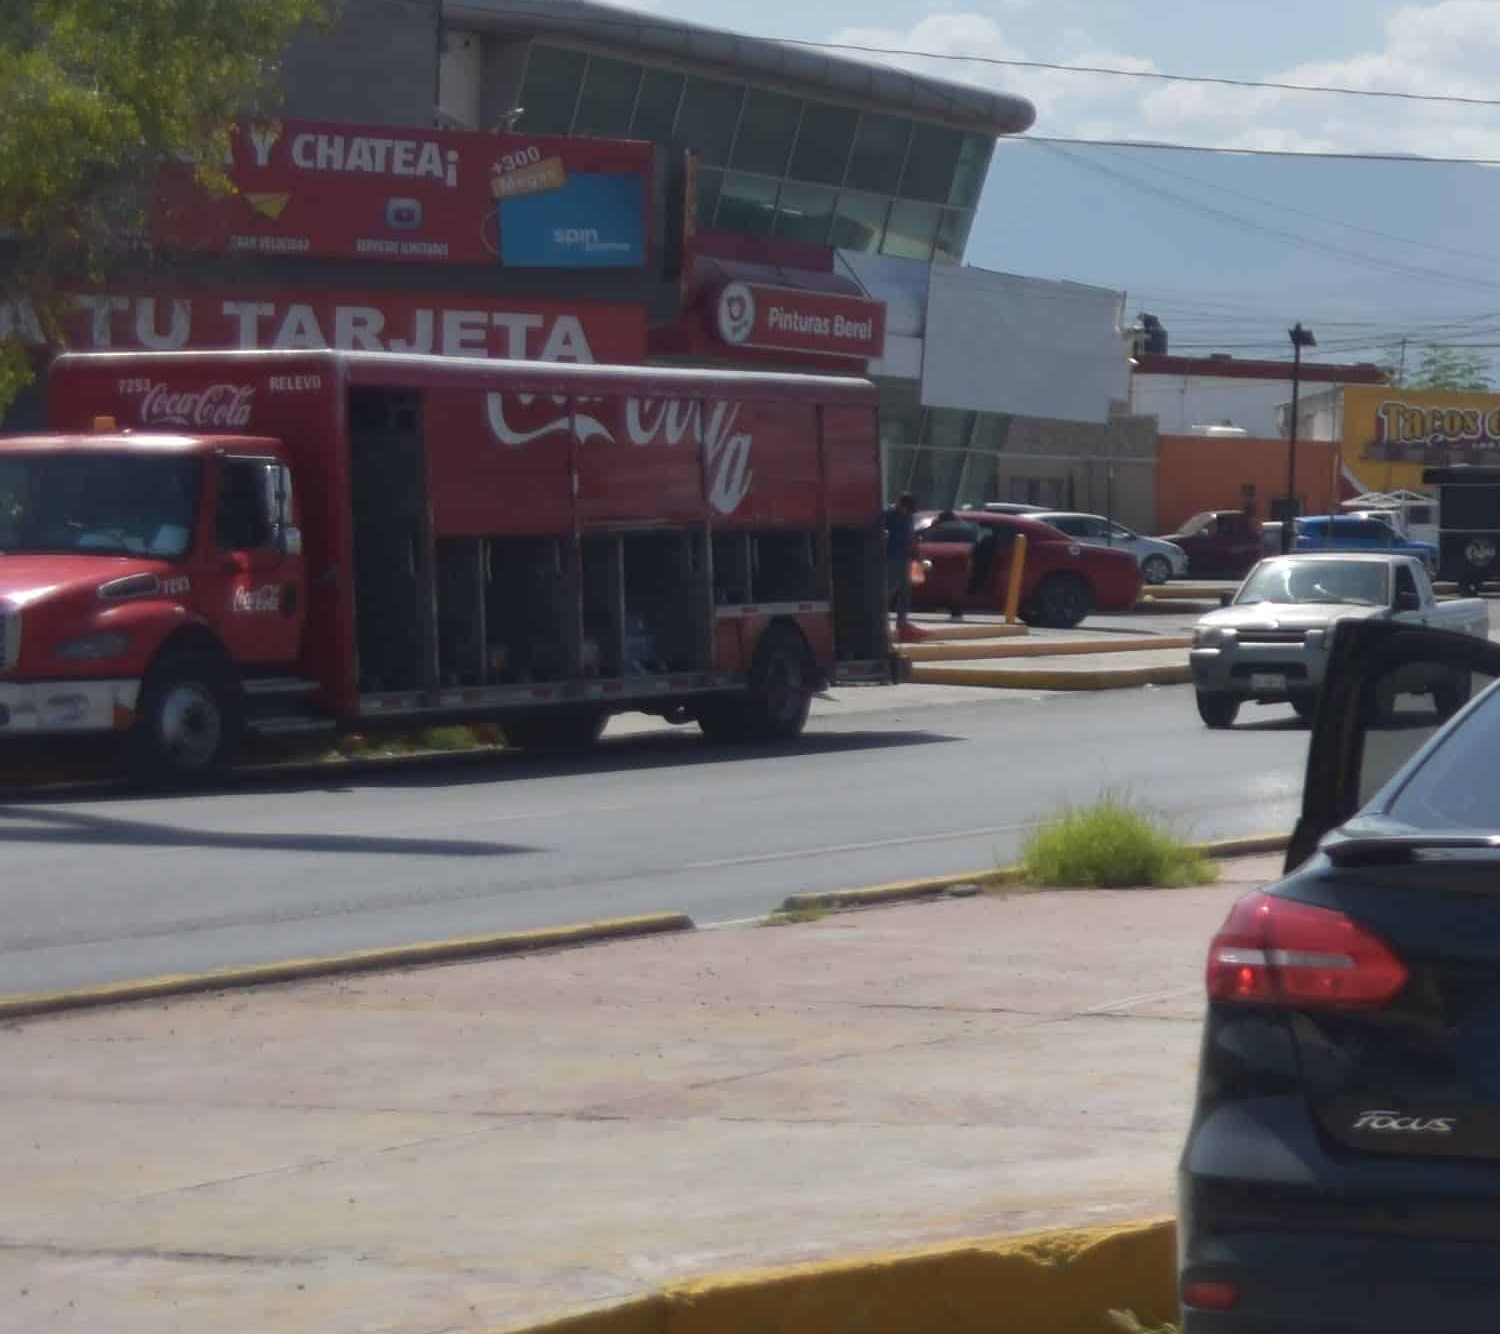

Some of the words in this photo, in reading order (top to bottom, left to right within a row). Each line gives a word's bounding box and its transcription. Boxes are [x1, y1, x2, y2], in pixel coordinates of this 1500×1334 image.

[552, 227, 600, 252] spin
[79, 293, 192, 350] TU
[221, 299, 598, 366] TARJETA
[768, 305, 830, 334] Pinturas
[833, 314, 872, 340] Berel
[268, 374, 321, 392] RELEVO
[1379, 402, 1482, 450] Tacos
[1352, 1110, 1457, 1132] FOCUS
